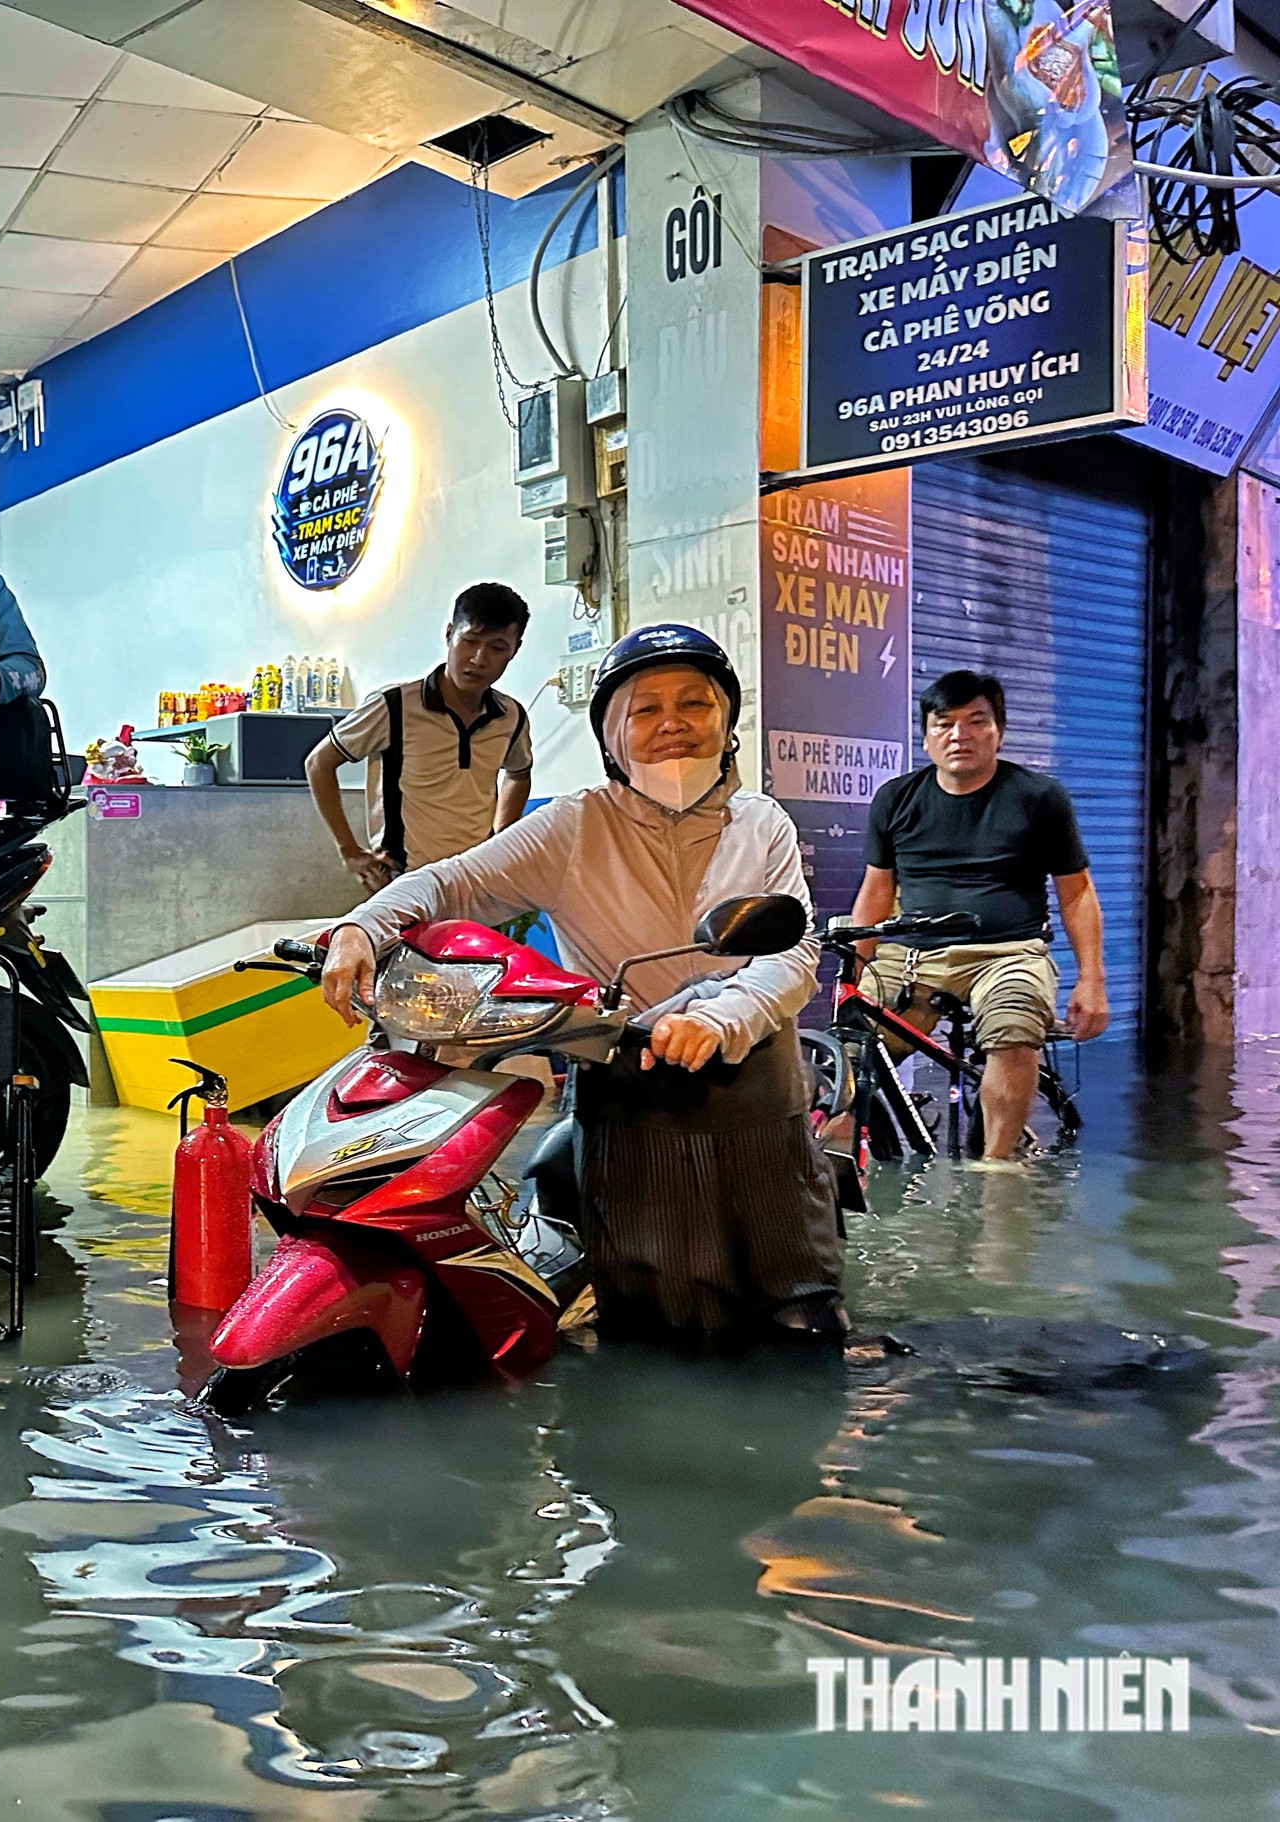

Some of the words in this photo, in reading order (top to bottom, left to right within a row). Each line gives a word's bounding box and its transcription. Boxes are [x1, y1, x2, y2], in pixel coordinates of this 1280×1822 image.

[821, 242, 905, 283] TRẠM
[910, 224, 970, 262] SẠC
[858, 286, 896, 316] XE
[901, 261, 970, 305] MÁY
[973, 241, 1058, 286] ĐIỆN
[863, 319, 898, 352] CÀ
[904, 303, 960, 344] PHÊ
[964, 290, 1051, 329] VÕNG
[917, 339, 990, 372] 24/24
[838, 395, 886, 420] 96A
[889, 377, 963, 410] PHAN
[968, 363, 1028, 394] HUY
[1031, 351, 1081, 381] ÍCH
[869, 417, 900, 432] SAU
[903, 410, 932, 427] 23H
[935, 405, 962, 419] VUI
[965, 395, 1009, 414] LÒNG
[1013, 387, 1043, 405] GỌI
[881, 410, 1030, 452] 0913543096
[288, 419, 369, 495] 96A
[312, 490, 330, 513] CÀ
[332, 480, 358, 507] PHÊ
[292, 542, 308, 562] XE
[309, 536, 337, 557] MÁY
[336, 527, 366, 551] ĐIỆN
[298, 514, 334, 541] TRẠM
[335, 507, 361, 532] SẠC
[772, 531, 819, 572] SẠC
[826, 542, 904, 587] NHANH
[775, 571, 816, 617] XE
[825, 581, 890, 630] MÁY
[785, 622, 859, 678] ĐIỆN
[778, 735, 798, 762] CÀ
[803, 739, 830, 765] PHÊ
[835, 744, 864, 768] PHA
[869, 744, 898, 770] MÁY
[805, 770, 852, 796] MANG
[859, 774, 873, 796] ĐI
[416, 1223, 472, 1242] HONDA
